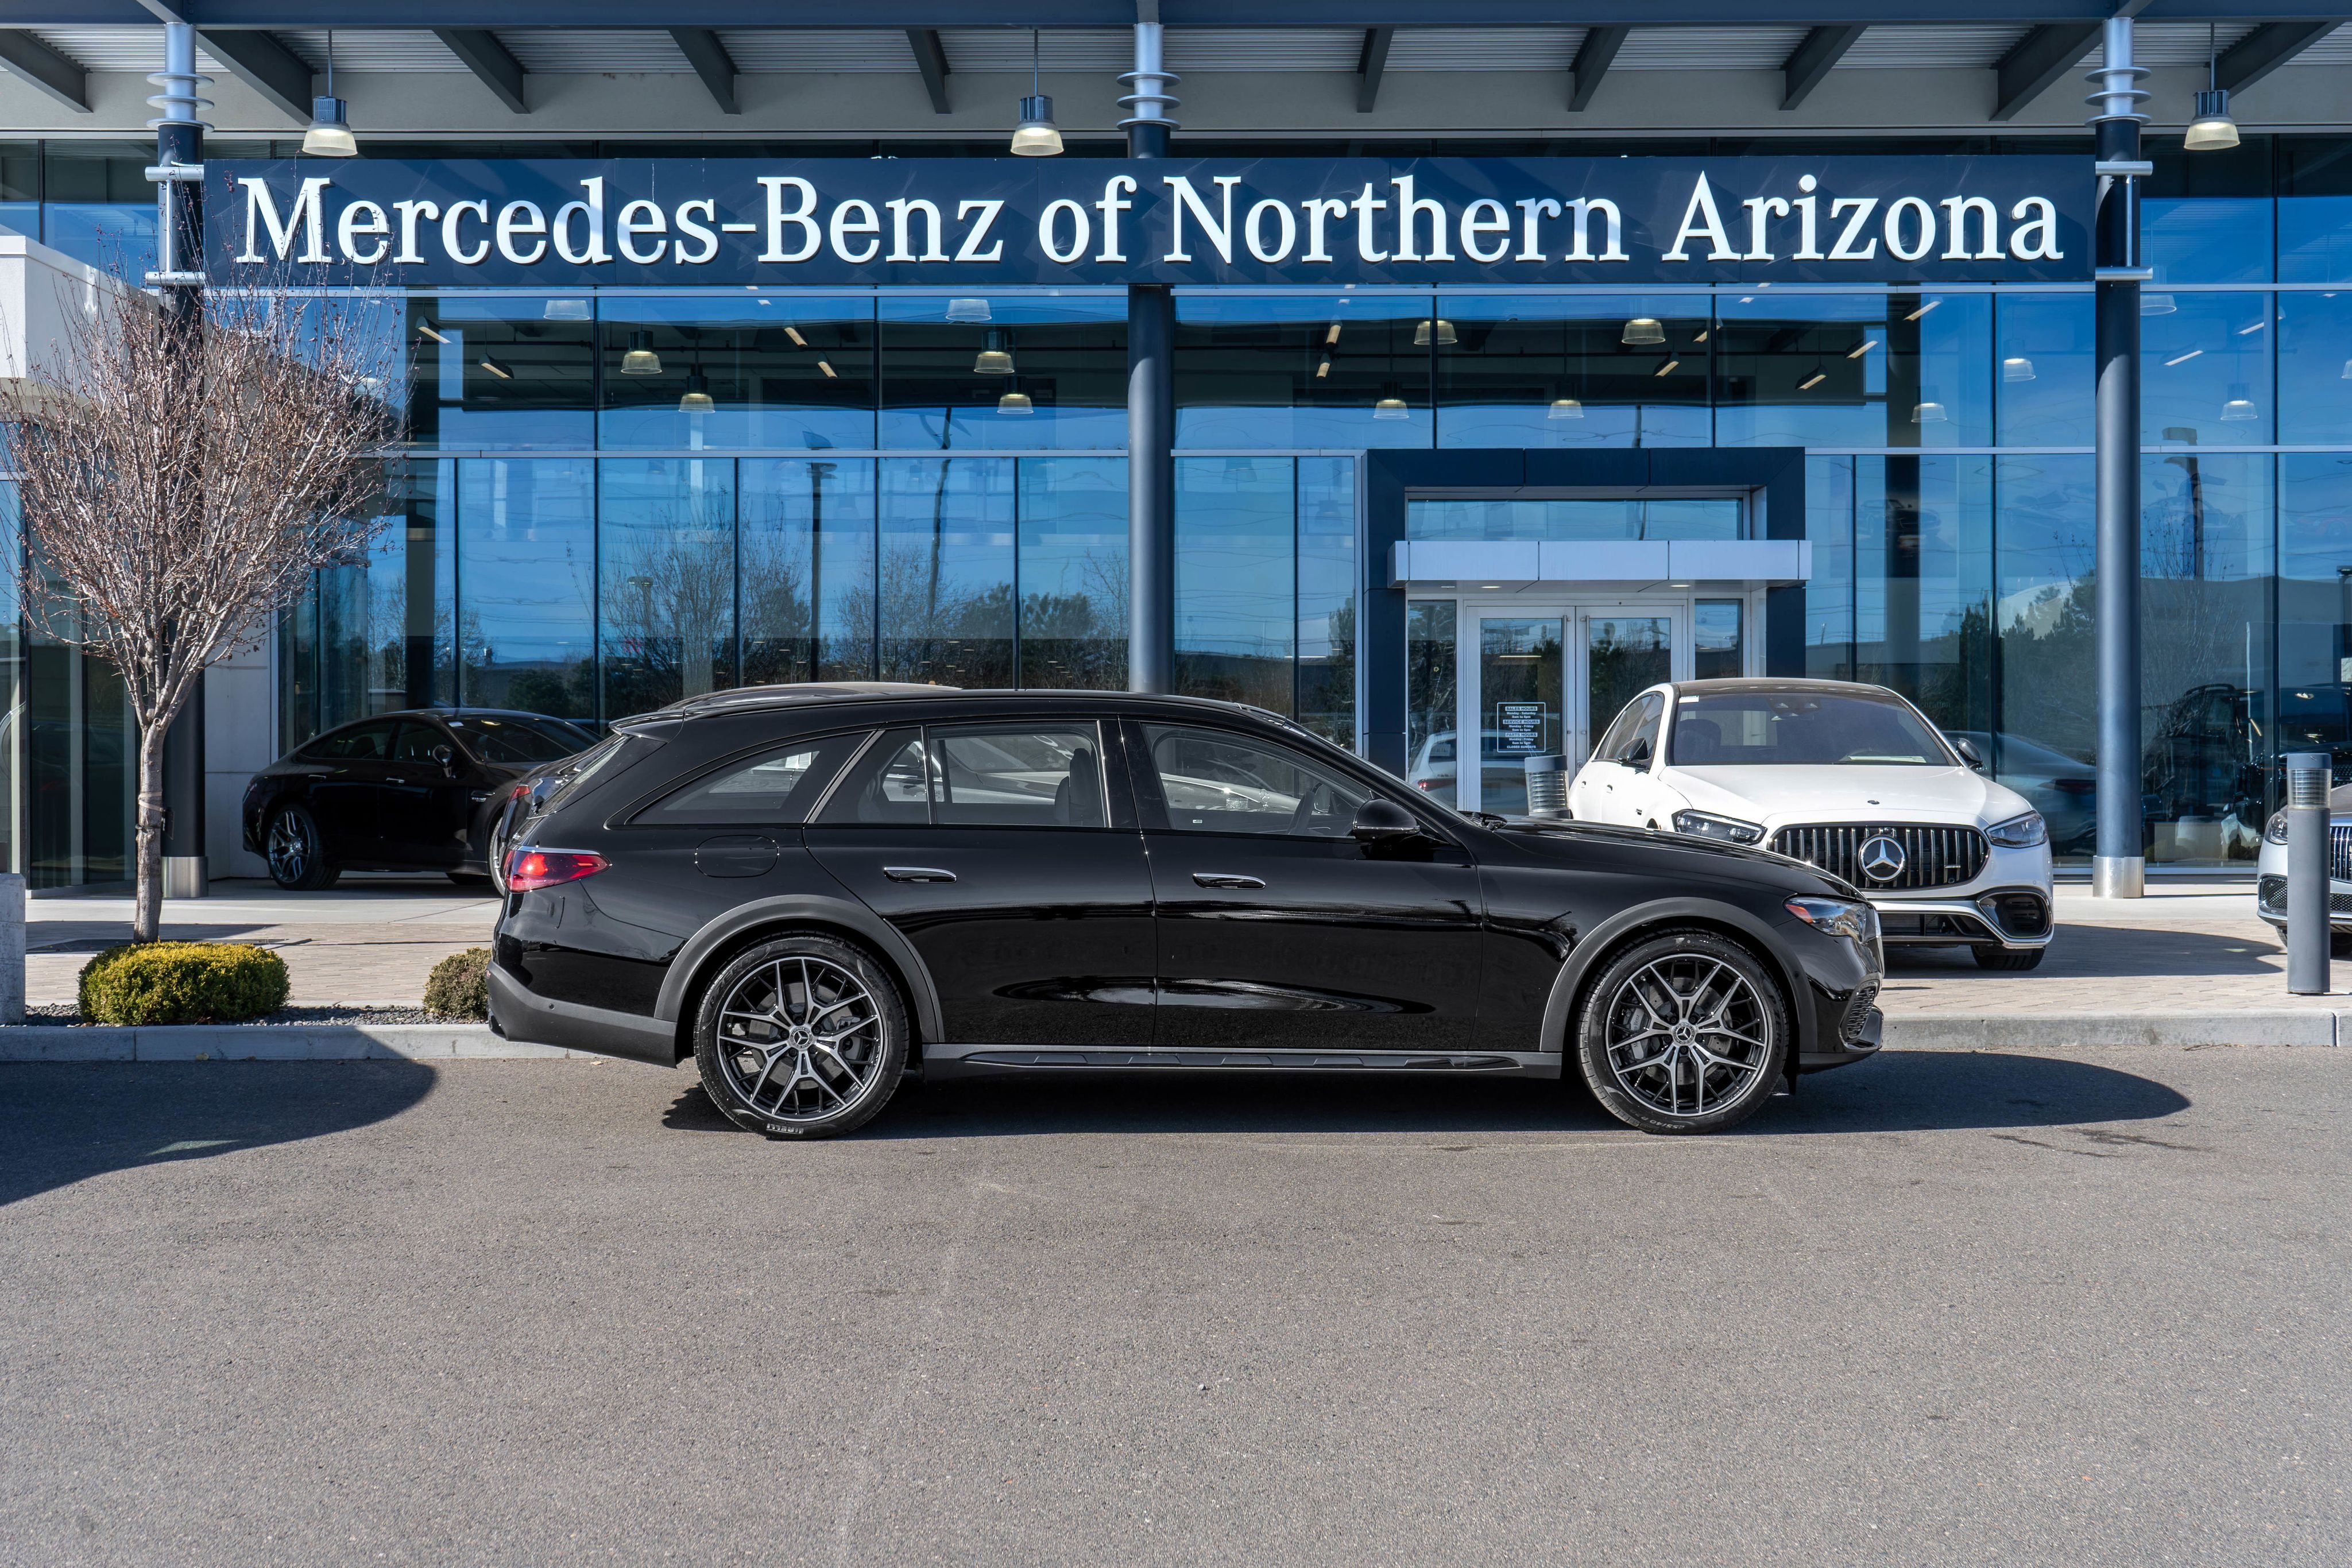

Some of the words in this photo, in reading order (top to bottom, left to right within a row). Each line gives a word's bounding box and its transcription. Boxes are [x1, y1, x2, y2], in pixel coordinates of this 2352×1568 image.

[236, 176, 1004, 264] Mercedes-Benz
[1038, 175, 1136, 264] of
[1163, 175, 1630, 264] Northern
[1662, 171, 2063, 261] Arizona
[767, 1123, 804, 1135] PIRELLI
